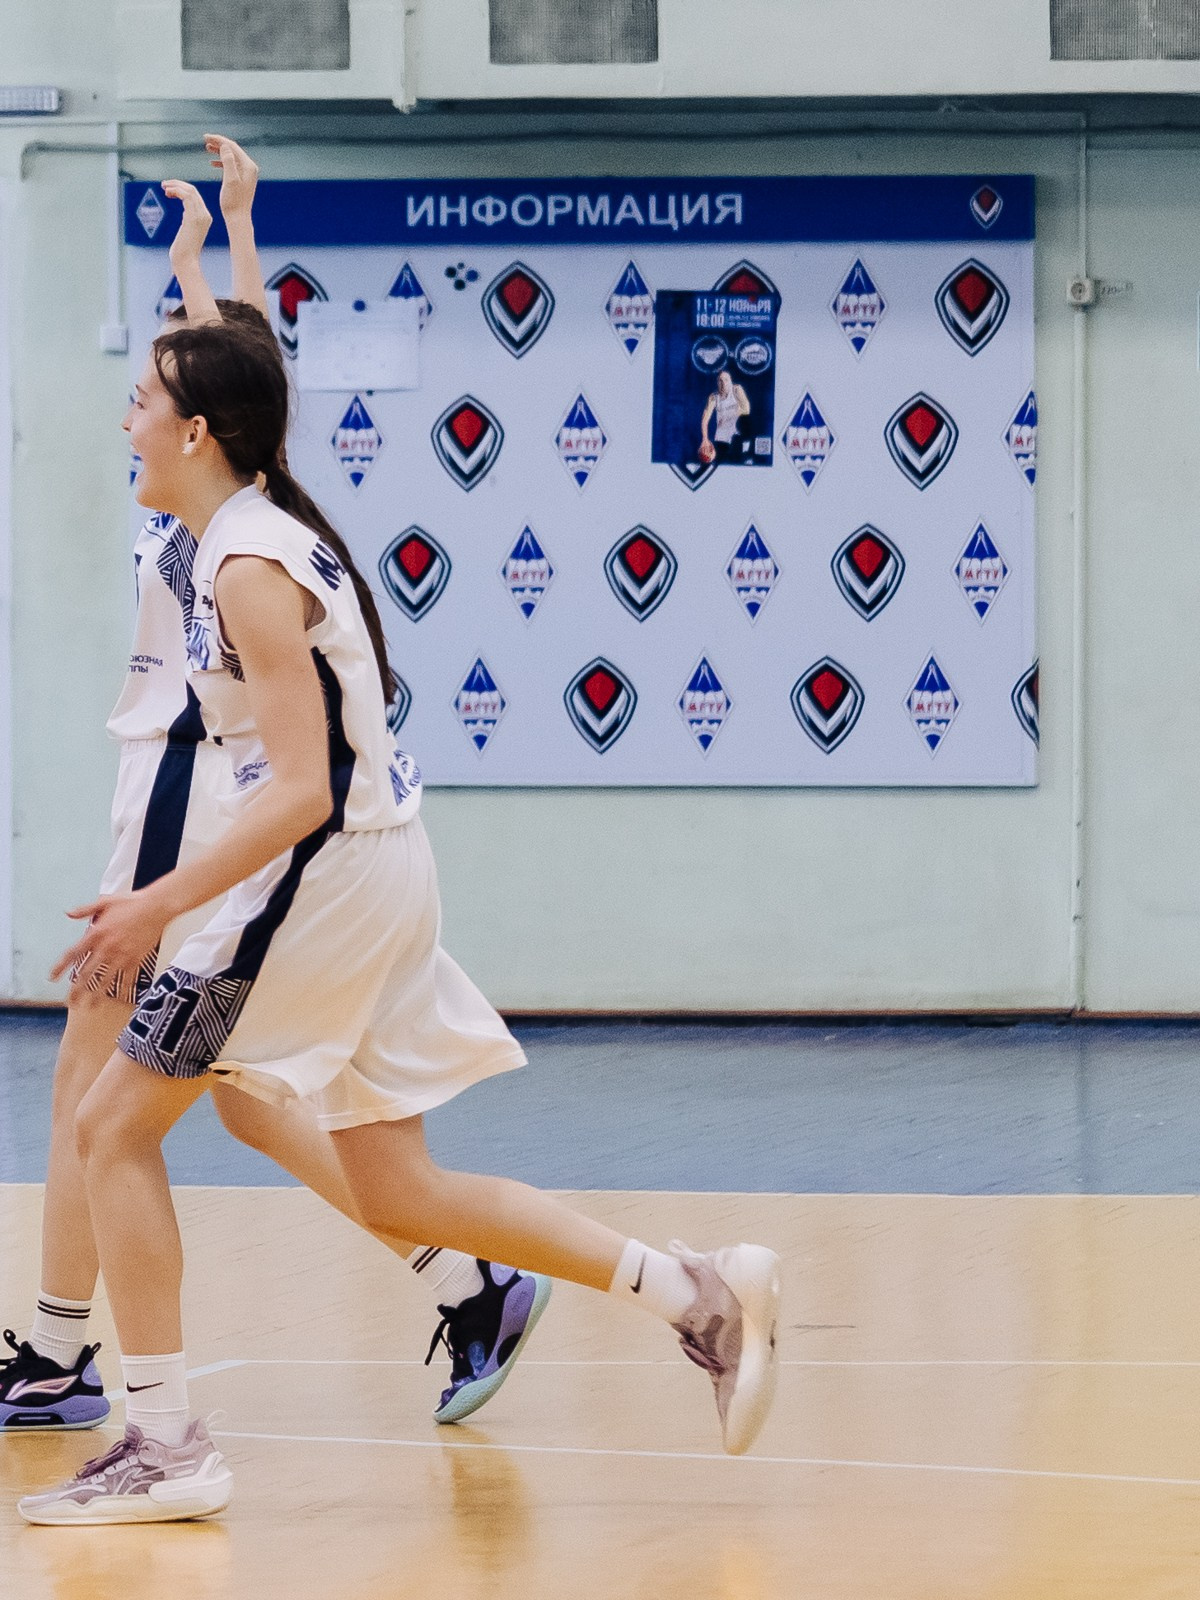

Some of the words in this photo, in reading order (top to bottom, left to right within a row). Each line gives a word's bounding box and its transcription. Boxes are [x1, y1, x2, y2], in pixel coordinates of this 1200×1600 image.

[406, 194, 743, 231] ИНФОРМАЦИЯ
[841, 304, 877, 315] МГТУ
[790, 438, 825, 449] МГТУ
[965, 569, 999, 579] МГТУ
[688, 703, 723, 712] МГТУ
[915, 702, 950, 712] МГТУ
